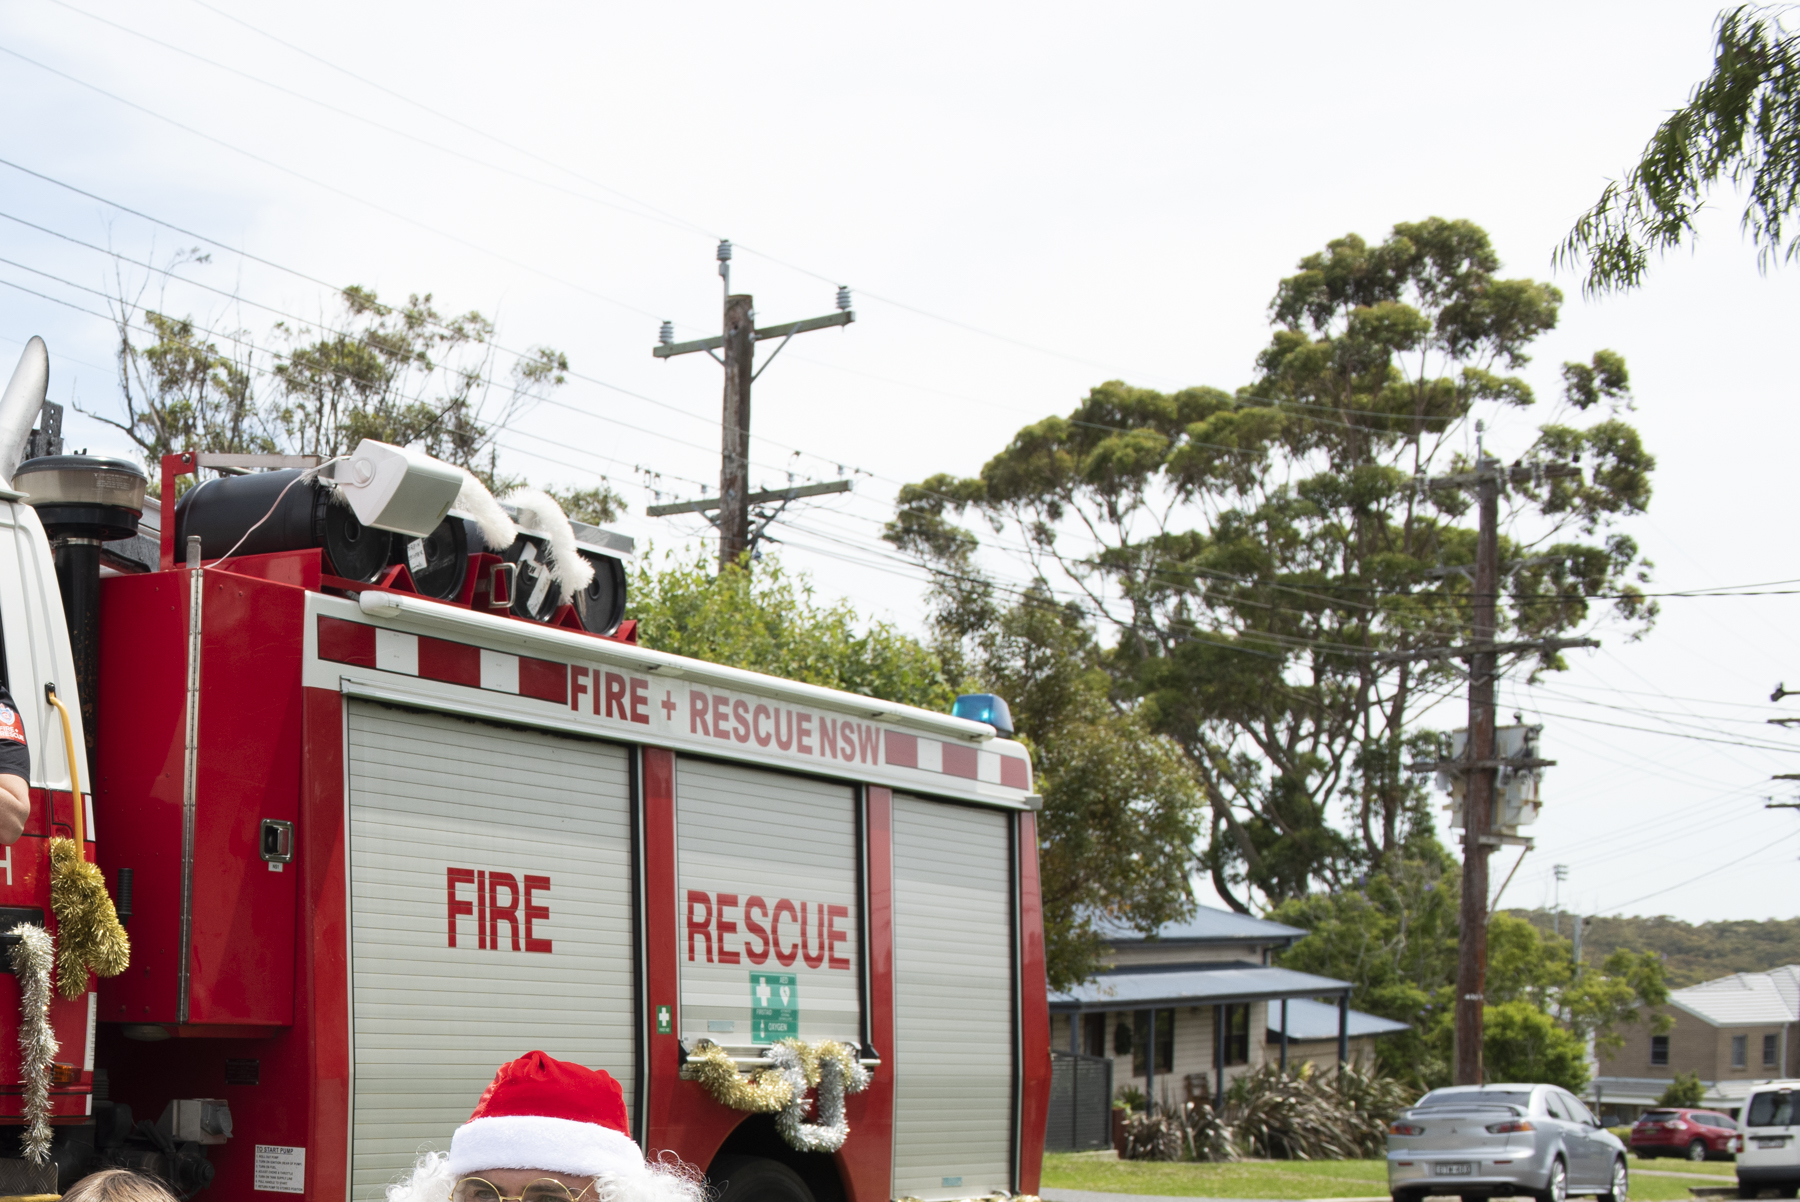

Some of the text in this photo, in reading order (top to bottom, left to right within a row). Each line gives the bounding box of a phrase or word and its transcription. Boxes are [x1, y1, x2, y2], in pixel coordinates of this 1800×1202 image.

[571, 664, 650, 725] FIRE
[689, 689, 813, 756] RESCUE
[819, 716, 881, 766] NSW
[447, 867, 553, 953] FIRE
[687, 889, 851, 970] RESCUE
